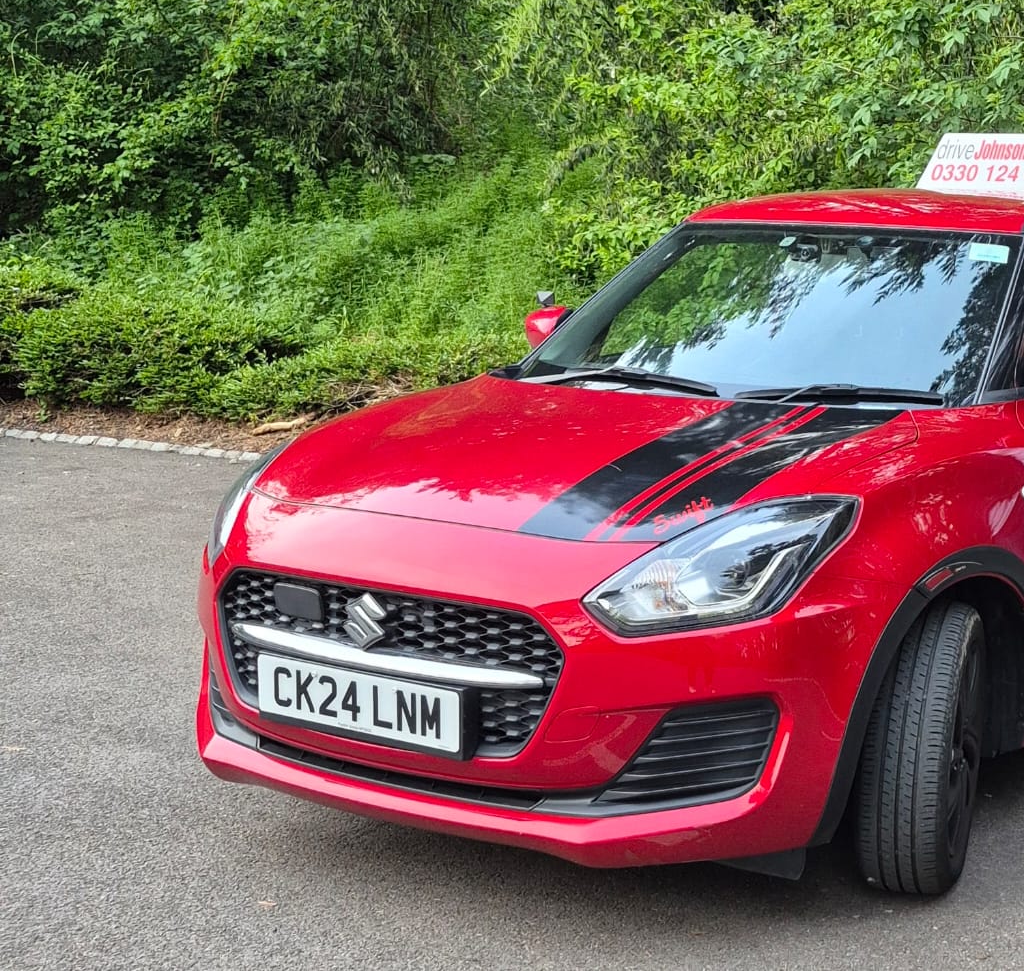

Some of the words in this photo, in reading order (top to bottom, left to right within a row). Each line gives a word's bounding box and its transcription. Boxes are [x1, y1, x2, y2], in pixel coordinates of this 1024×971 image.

[931, 164, 979, 182] 0330
[986, 165, 1019, 183] 124
[653, 496, 714, 535] Swift
[273, 666, 361, 722] CK24
[372, 685, 441, 739] LNM
